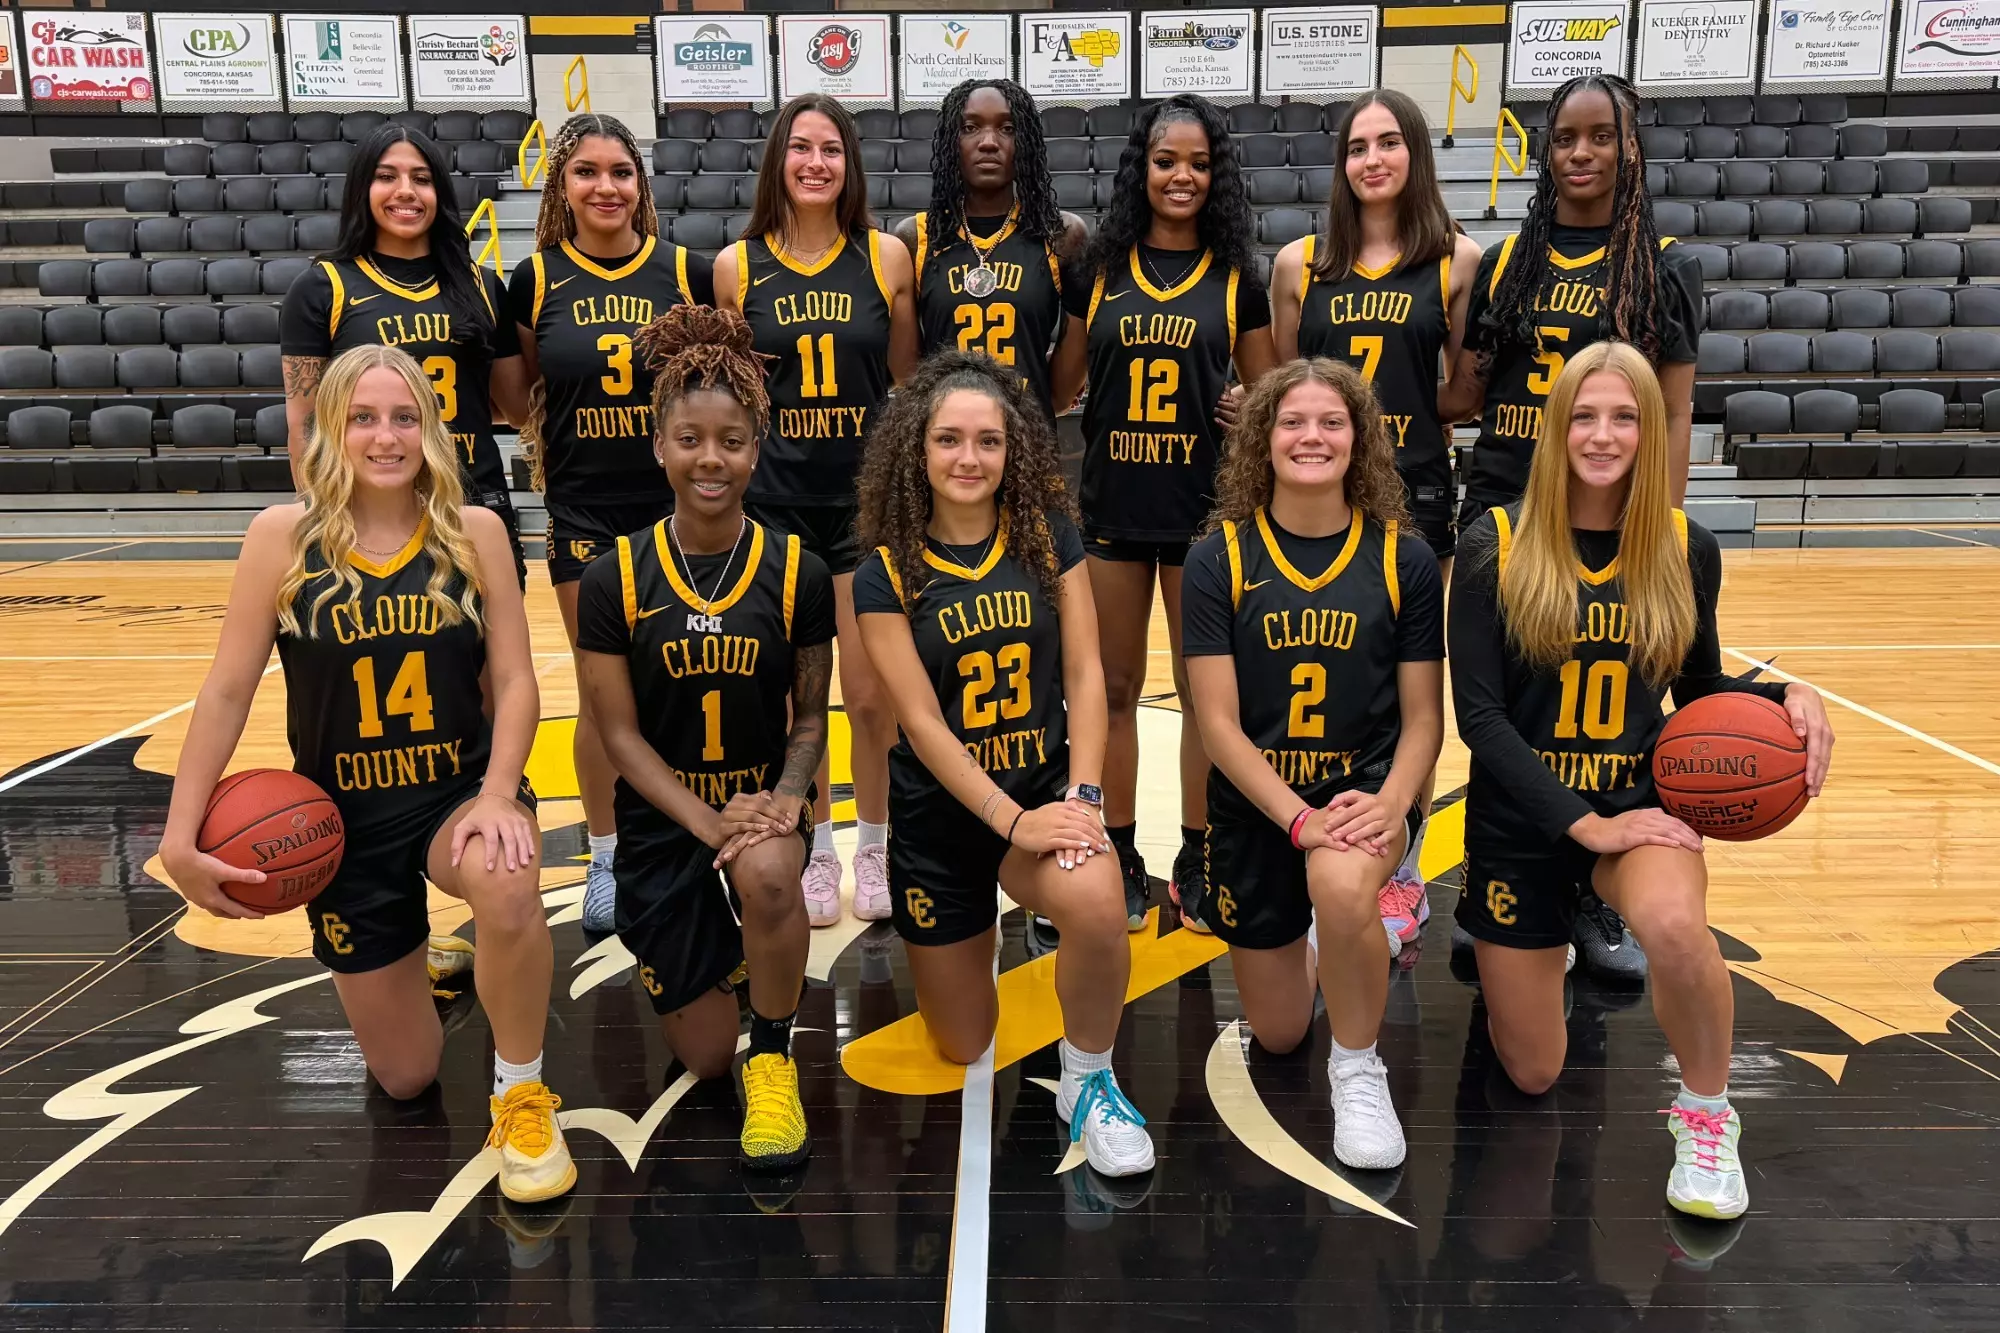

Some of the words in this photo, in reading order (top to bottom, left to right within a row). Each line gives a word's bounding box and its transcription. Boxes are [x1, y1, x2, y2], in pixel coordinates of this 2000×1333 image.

[1149, 26, 1184, 38] Farm
[1193, 24, 1246, 38] Country
[1278, 27, 1305, 39] U.S.
[1309, 25, 1363, 38] STONE
[1519, 14, 1621, 45] SUBWAY
[1651, 17, 1700, 27] KUEKER
[1702, 15, 1747, 25] FAMILY
[1664, 28, 1731, 39] DENTISTRY
[1803, 11, 1836, 27] Family
[1839, 11, 1859, 26] Eye
[1861, 10, 1884, 21] Care
[1939, 16, 2000, 30] Cunningham
[190, 29, 238, 51] CPA
[349, 31, 382, 39] Concordia
[352, 43, 382, 51] Belleville
[417, 41, 444, 49] Christy
[447, 40, 479, 48] Bechard
[808, 36, 844, 63] Easy
[847, 30, 861, 56] G
[1210, 39, 1231, 48] Ford
[1294, 40, 1345, 48] INDUSTRIES
[31, 46, 78, 68] CAR
[81, 47, 145, 68] WASH
[294, 61, 344, 72] CITIZENS
[349, 56, 363, 64] Clay
[420, 51, 454, 60] INSURANCE
[455, 52, 479, 60] AGENCY
[679, 44, 746, 61] Geisler
[907, 53, 935, 65] North
[937, 53, 971, 65] Central
[974, 54, 1005, 65] Kansas
[1534, 51, 1602, 60] CONCORDIA
[1803, 61, 1819, 69] (785)
[295, 72, 348, 84] NATIONAL
[924, 67, 957, 78] Medical
[960, 67, 988, 78] Center
[1163, 77, 1187, 87] (785)
[1189, 76, 1231, 85] 243-1220
[1165, 65, 1203, 73] Concordia,
[1531, 67, 1559, 76] CLAY
[1562, 67, 1603, 76] CENTER
[57, 88, 127, 98] cjs-carwash.com
[297, 84, 328, 95] BANK
[948, 261, 1023, 294] CUD
[573, 294, 653, 326] CLOUD
[774, 291, 852, 325] CLOUD
[1330, 291, 1412, 325] CLOUD
[377, 313, 462, 347] CLOU
[954, 302, 1016, 366] 22
[1119, 313, 1197, 349] CLOUD
[597, 333, 633, 396] 3
[796, 333, 838, 398] 11
[1350, 335, 1384, 390] 7
[1526, 326, 1571, 396] 5
[1127, 357, 1180, 423] 12
[575, 404, 656, 438] COUNT
[779, 406, 867, 439] COUNTY
[1495, 403, 1544, 440] COUN
[1109, 430, 1198, 465] COUNTY
[331, 594, 439, 645] CLOUD
[686, 613, 723, 634] KHI
[938, 590, 1032, 644] CLOUD
[1263, 608, 1357, 650] CLOUD
[662, 635, 760, 679] CLOUD
[352, 650, 435, 738] 14
[956, 642, 1032, 730] 23
[1287, 662, 1327, 738] 2
[1554, 660, 1629, 740] 10
[701, 689, 725, 762] 1
[335, 738, 462, 791] COUNTY
[965, 727, 1047, 772] UNTY
[1257, 747, 1361, 786] OUNTY
[1533, 750, 1645, 792] OUNTY
[1660, 754, 1758, 779] SPALDING
[671, 763, 770, 805] UNTY
[1667, 797, 1759, 819] LEGACY
[251, 812, 341, 866] SPALDING
